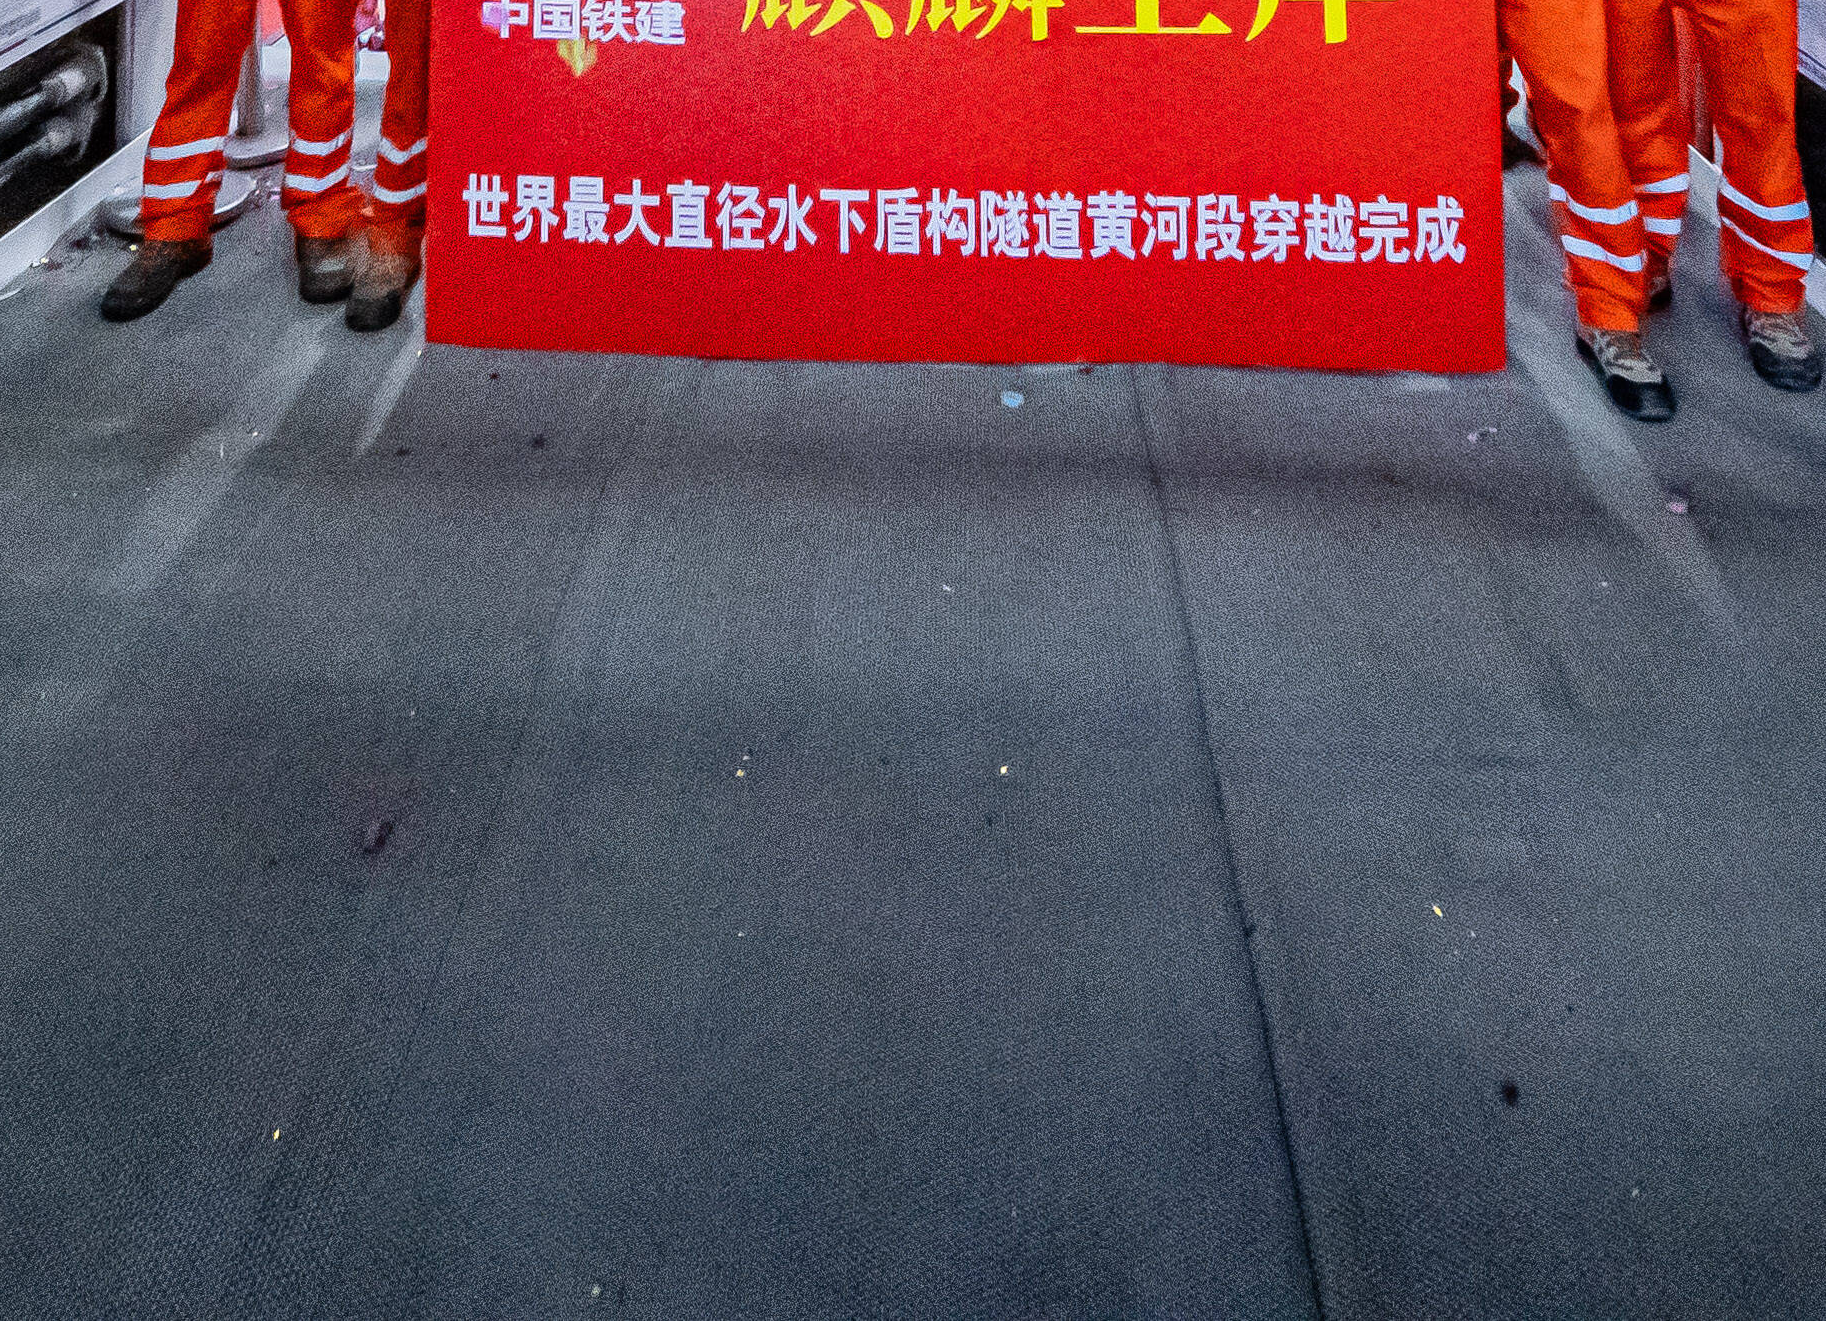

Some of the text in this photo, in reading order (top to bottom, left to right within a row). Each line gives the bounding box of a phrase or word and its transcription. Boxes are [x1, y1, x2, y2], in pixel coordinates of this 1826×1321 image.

[462, 173, 1466, 265] 世界最大直径水下盾构隧道黄河段穿越完成
